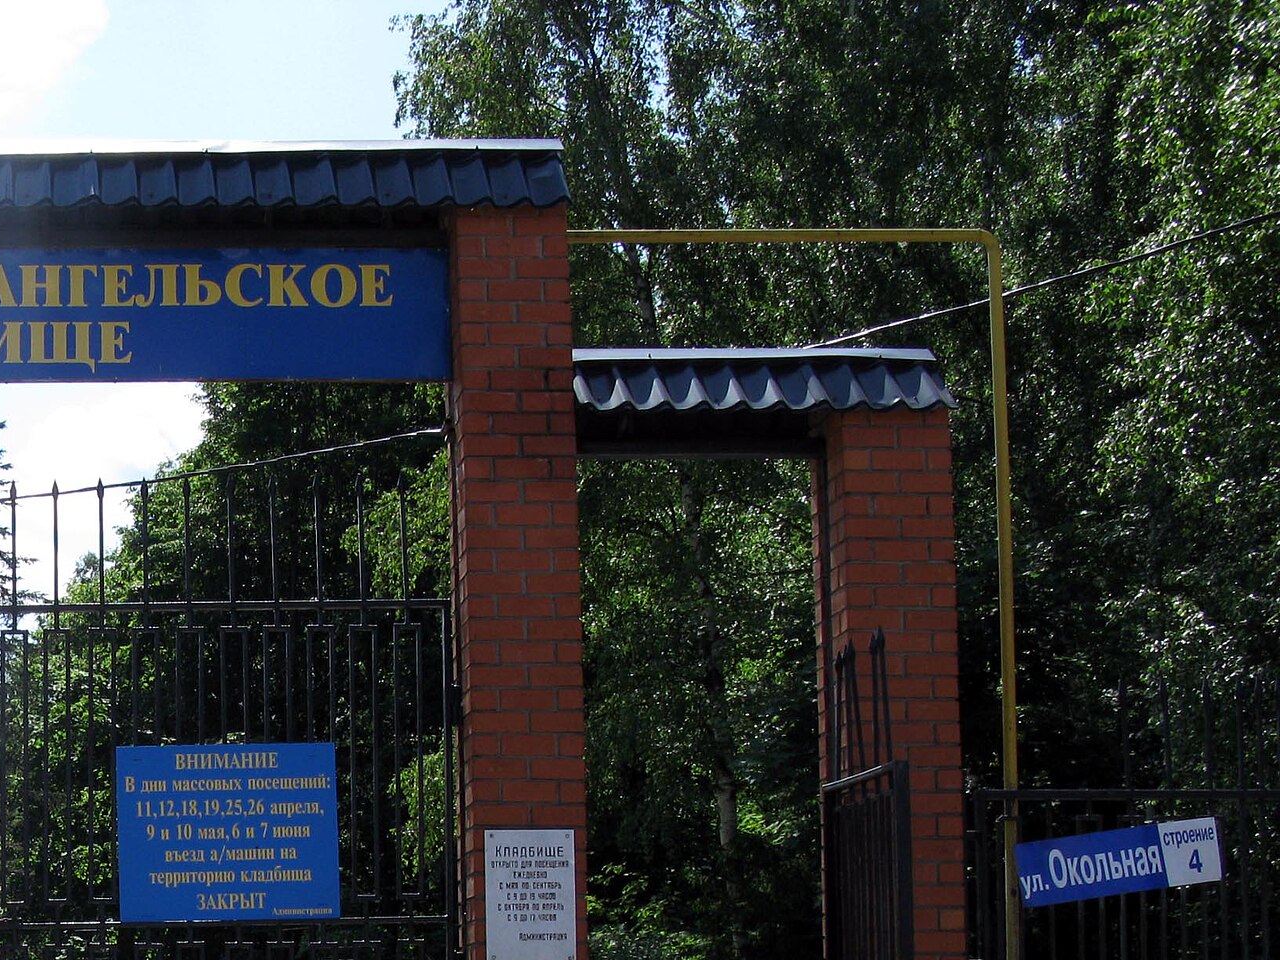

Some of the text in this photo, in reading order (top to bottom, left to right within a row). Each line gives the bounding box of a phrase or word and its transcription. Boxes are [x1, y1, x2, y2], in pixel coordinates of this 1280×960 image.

[175, 752, 278, 769] ВНИМАНИЕ
[125, 774, 330, 793] В дни массовых посещений:
[137, 799, 324, 818] 11,12,18,19,25,26 апреля,
[147, 825, 154, 840] 9
[161, 829, 169, 839] и
[177, 825, 192, 840] 10
[246, 828, 254, 838] и
[261, 822, 268, 838] 7
[273, 825, 310, 838] июня
[1163, 827, 1214, 848] строение
[165, 845, 297, 864] въезд а/машин на
[496, 846, 564, 858] КЛАДБИЩЕ
[1189, 849, 1203, 873] 4
[150, 866, 312, 887] территорию кладбища
[1021, 845, 1162, 899] ул. Окольная
[197, 893, 266, 910] ЗАКРЫТ
[272, 907, 332, 916] Администрация
